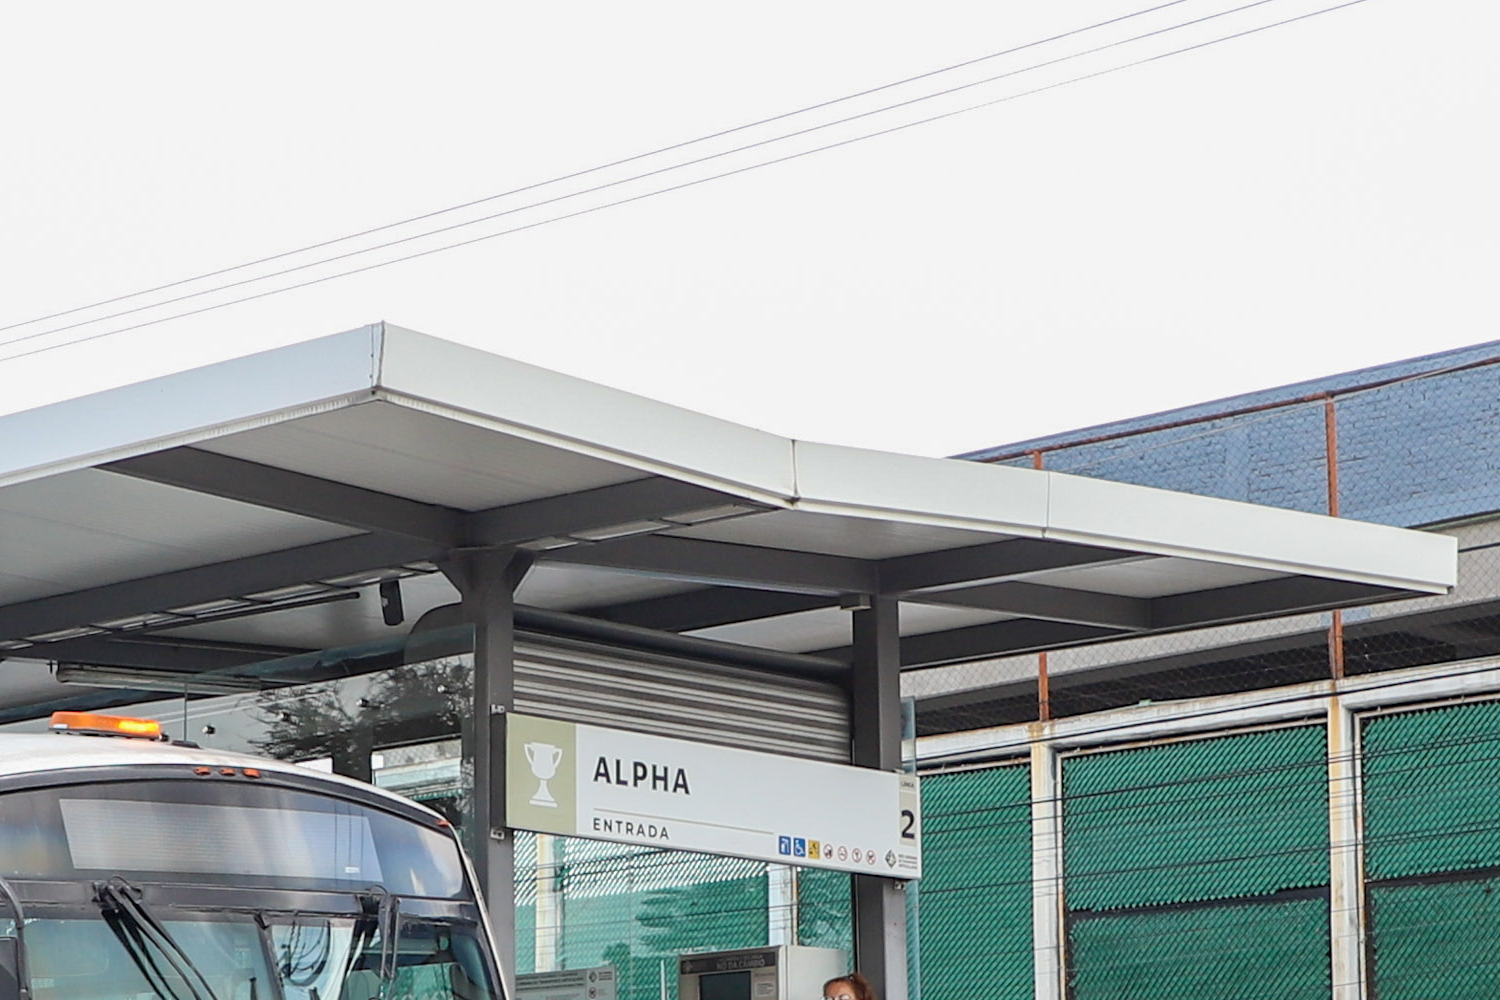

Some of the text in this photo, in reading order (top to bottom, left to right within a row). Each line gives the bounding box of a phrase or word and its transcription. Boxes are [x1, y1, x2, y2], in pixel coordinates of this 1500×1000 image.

[593, 756, 690, 795] ALPHA
[592, 817, 670, 840] ENTRADA
[901, 809, 915, 839] 2
